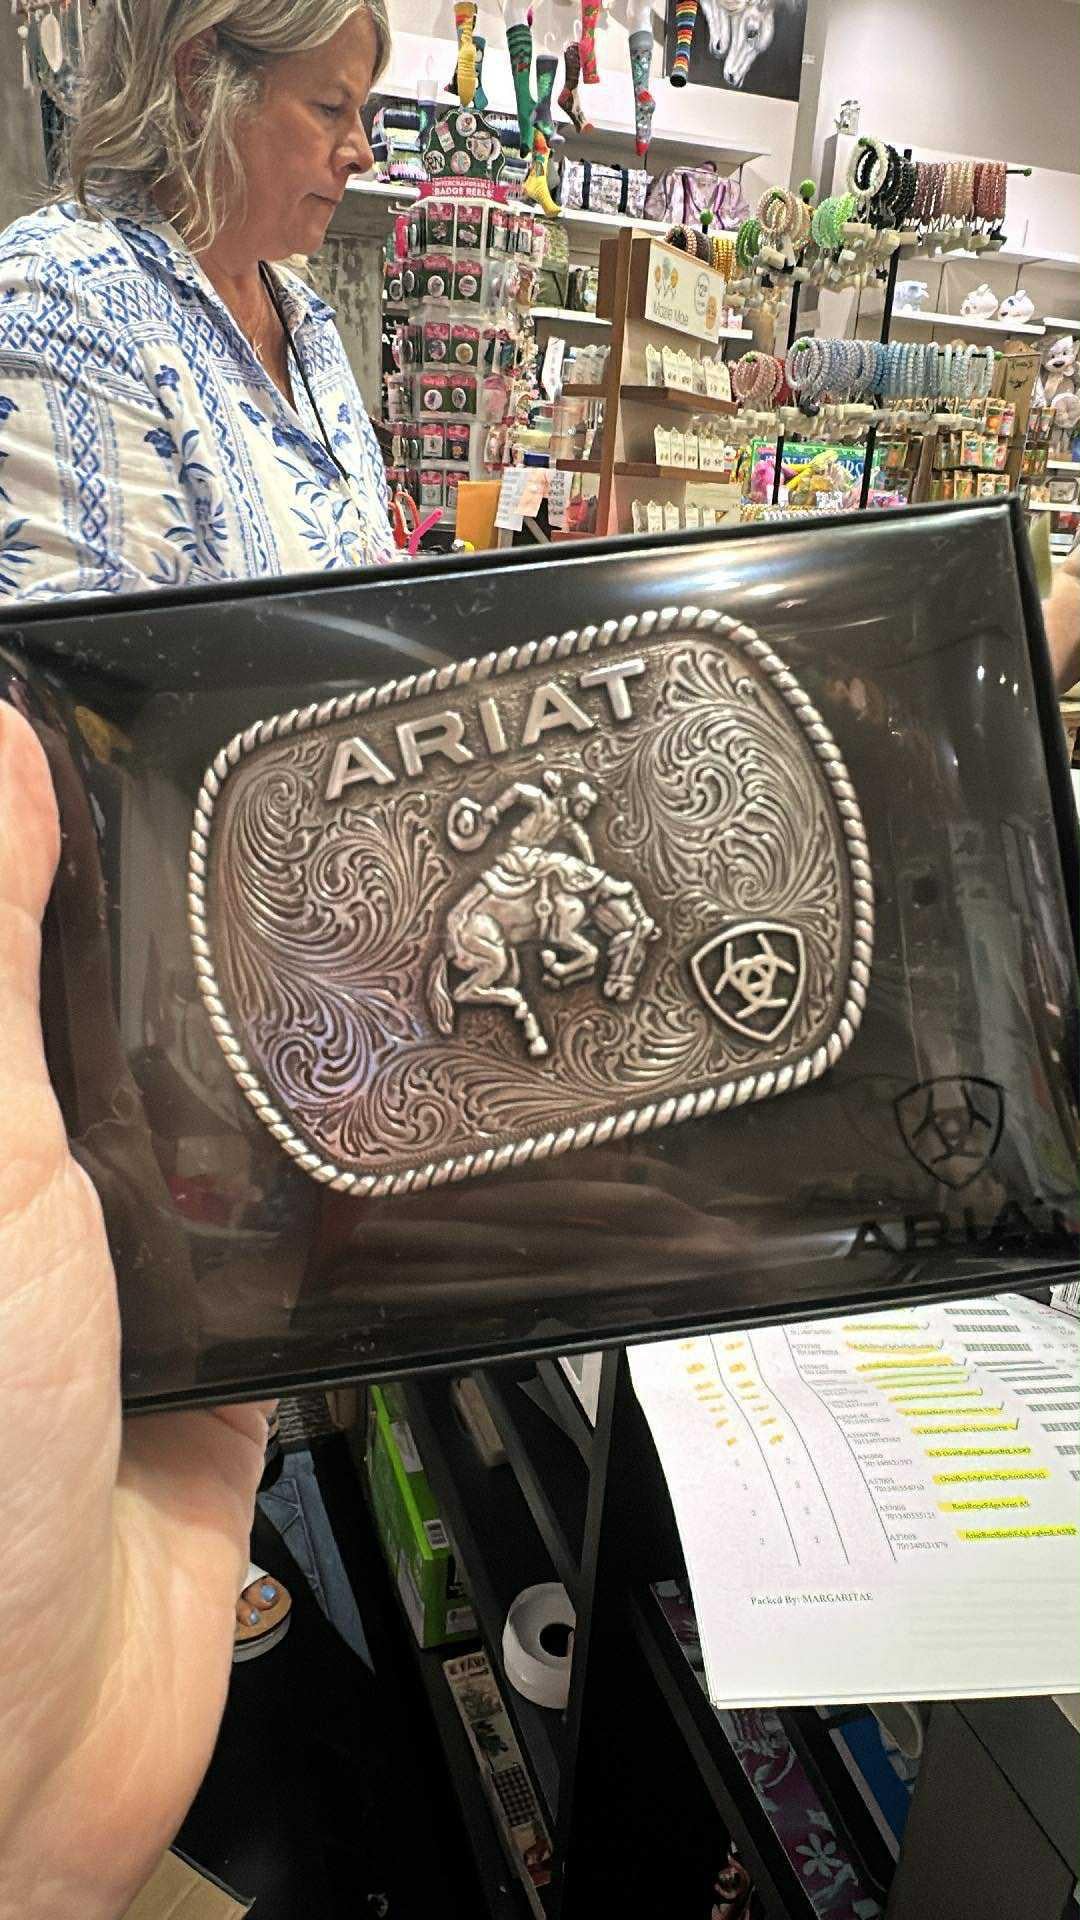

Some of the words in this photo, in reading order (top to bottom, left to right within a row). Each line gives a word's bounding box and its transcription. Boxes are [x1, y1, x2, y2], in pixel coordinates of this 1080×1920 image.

[434, 187, 464, 196] BADGE
[465, 187, 494, 198] REELS
[324, 657, 647, 801] ARIAT
[750, 1594, 783, 1605] Packed
[802, 1592, 873, 1603] MARGARITAE
